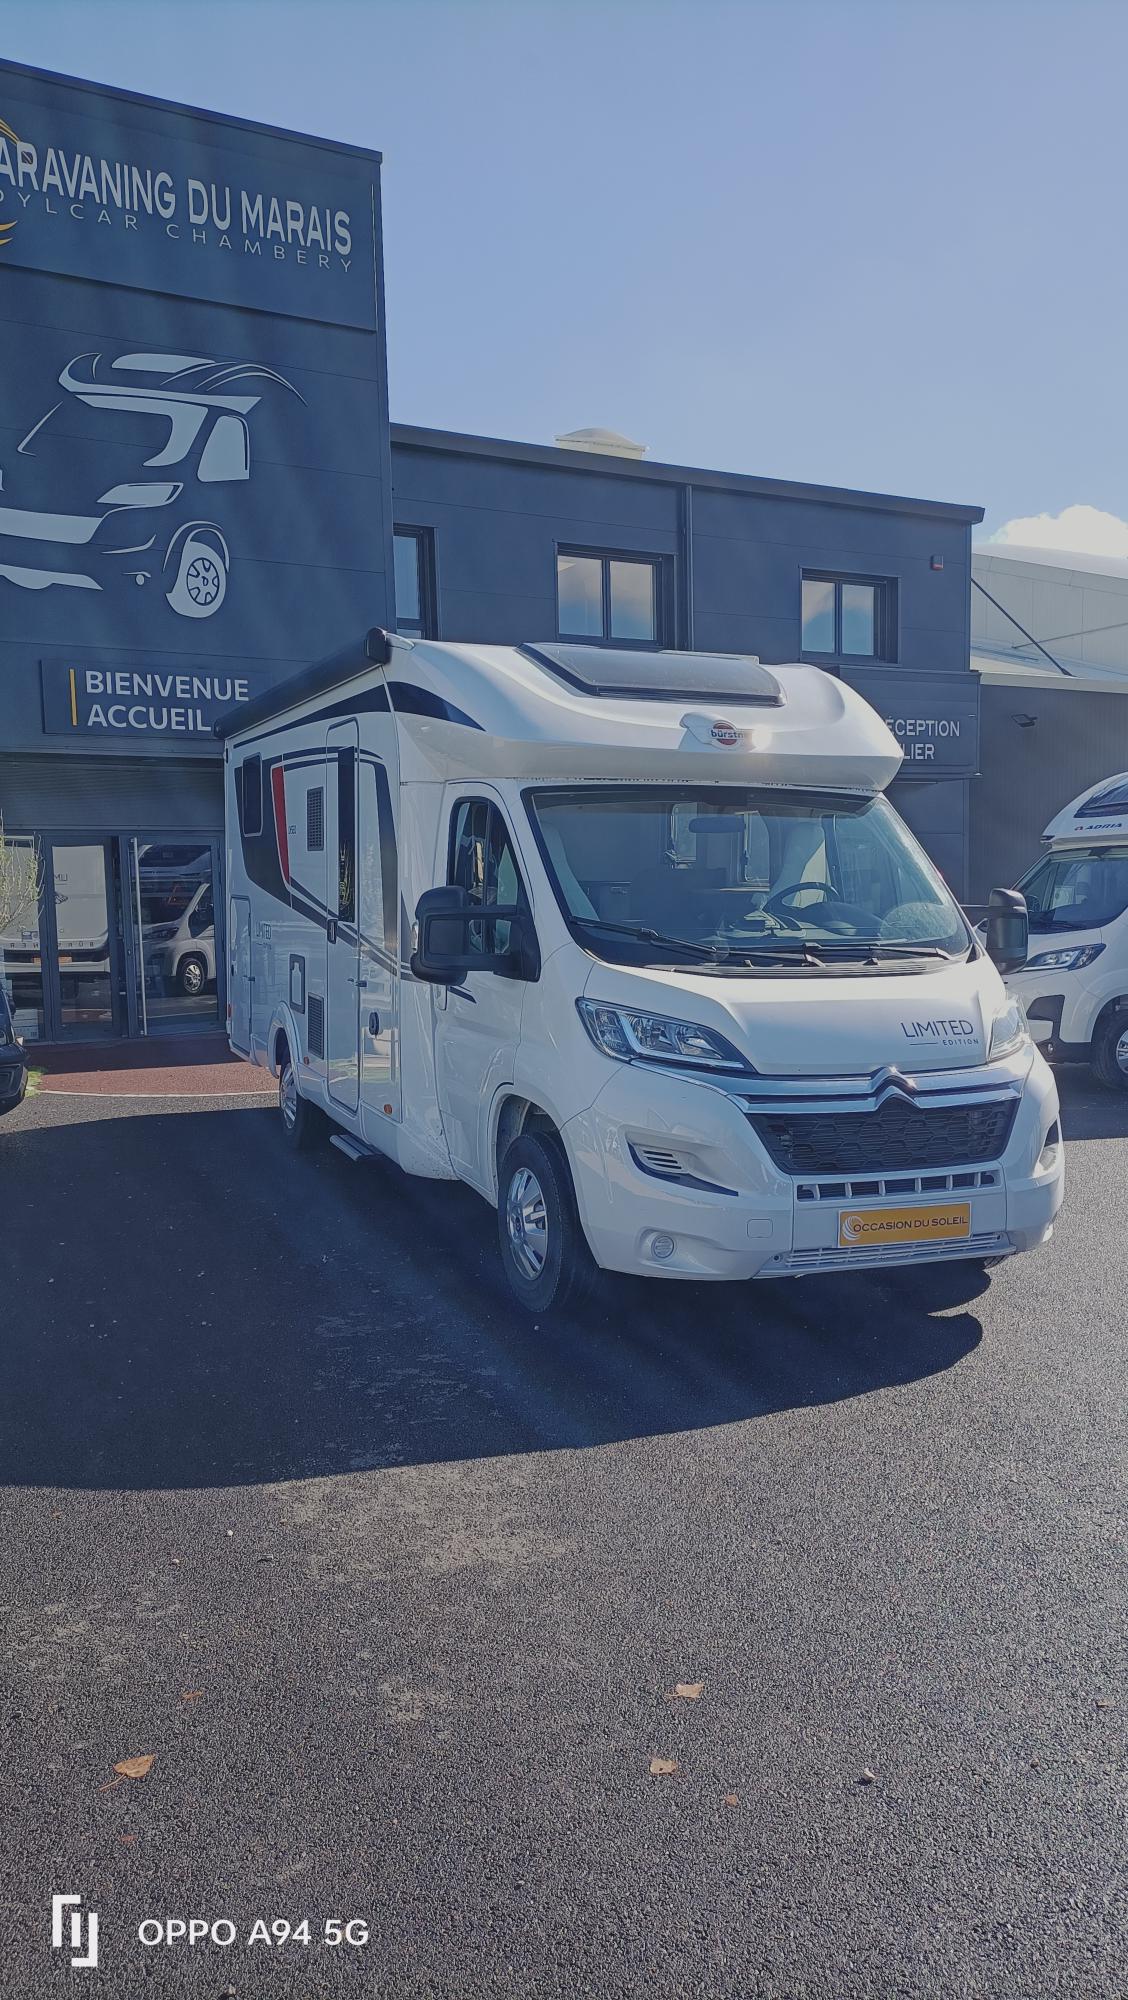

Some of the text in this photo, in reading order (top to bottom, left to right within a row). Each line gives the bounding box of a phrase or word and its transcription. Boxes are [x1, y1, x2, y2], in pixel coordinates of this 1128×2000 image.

[188, 179, 231, 230] DU
[241, 190, 352, 256] MARAIS
[166, 224, 352, 273] CHAMBERY
[85, 671, 249, 701] BIENVENUE
[87, 704, 212, 732] ACCUEIL
[885, 716, 960, 737] ÉCEPTION
[711, 730, 744, 738] bürstn
[901, 743, 935, 760] LIER
[900, 1020, 974, 1038] LIMITED
[853, 1216, 968, 1233] OCCASION DU SOLEIL
